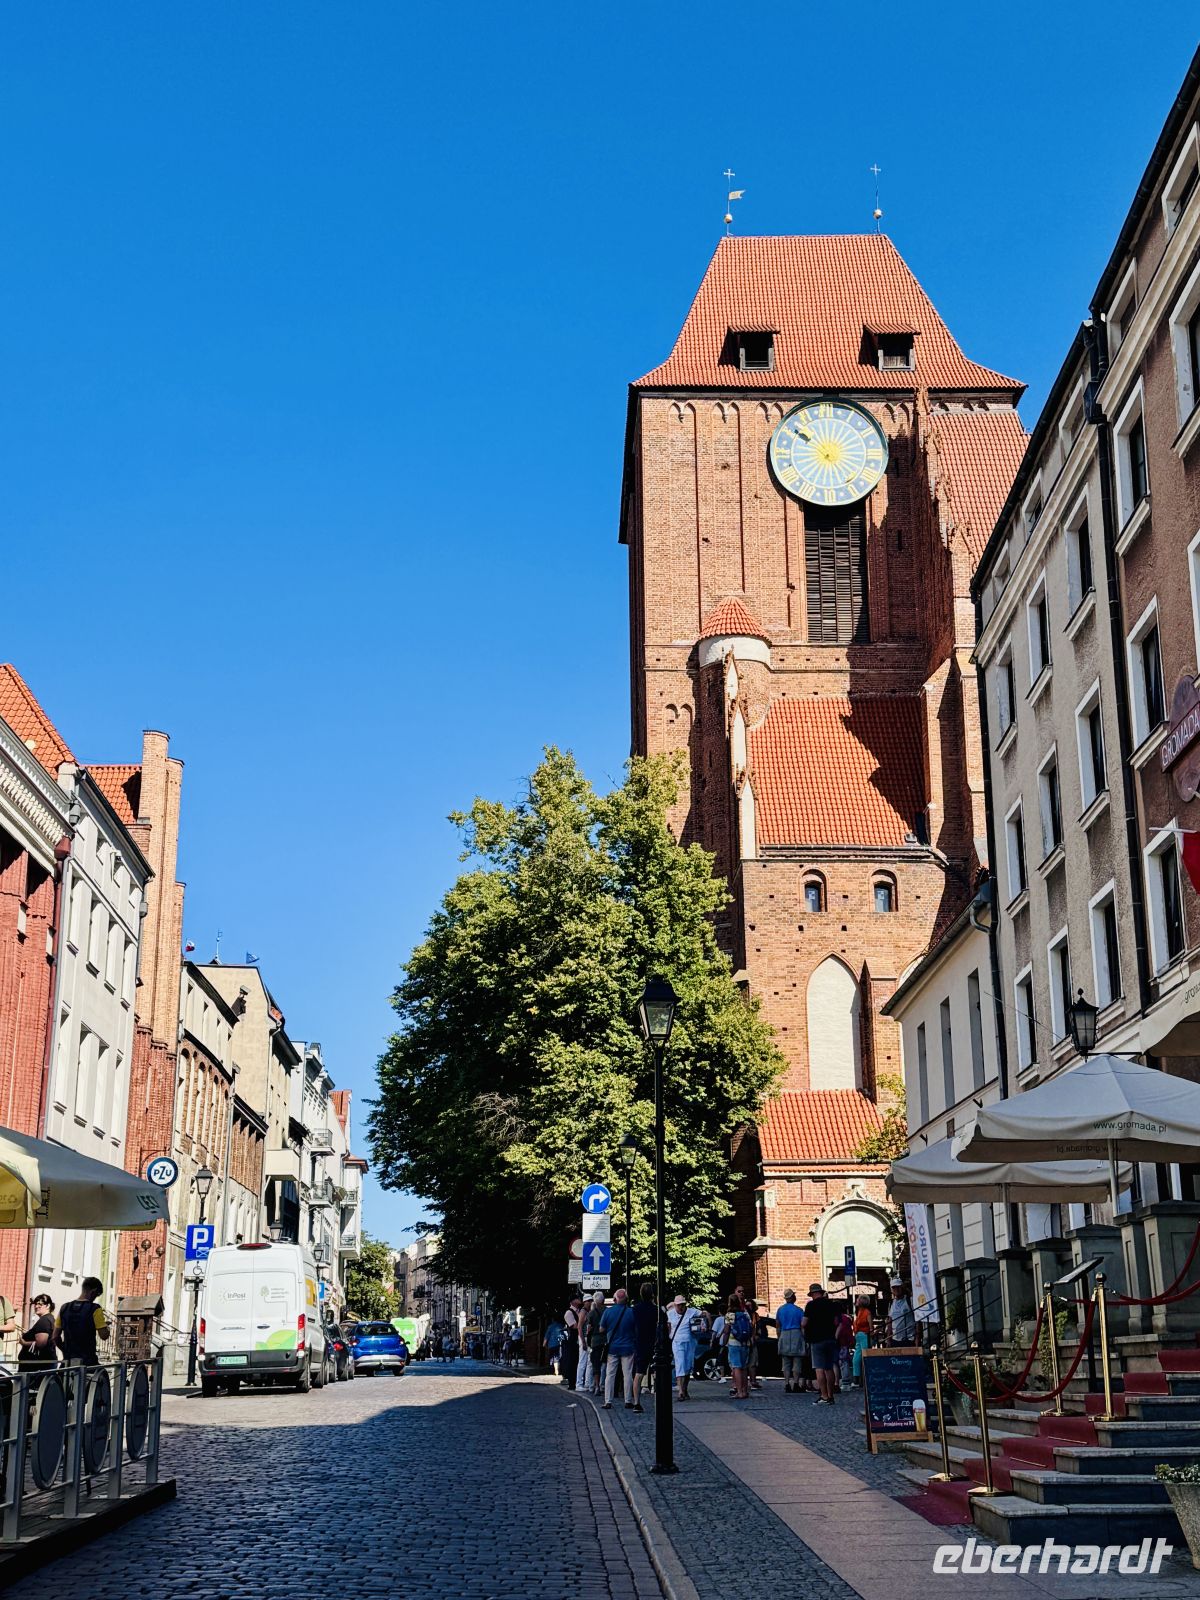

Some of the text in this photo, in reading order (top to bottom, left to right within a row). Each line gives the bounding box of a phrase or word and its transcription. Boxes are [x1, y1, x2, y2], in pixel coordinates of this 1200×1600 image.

[1161, 709, 1200, 766] GROMADA
[1092, 1120, 1168, 1135] www.gromada.pl
[154, 1165, 172, 1180] PZU
[192, 1228, 209, 1249] P
[846, 1248, 853, 1266] P
